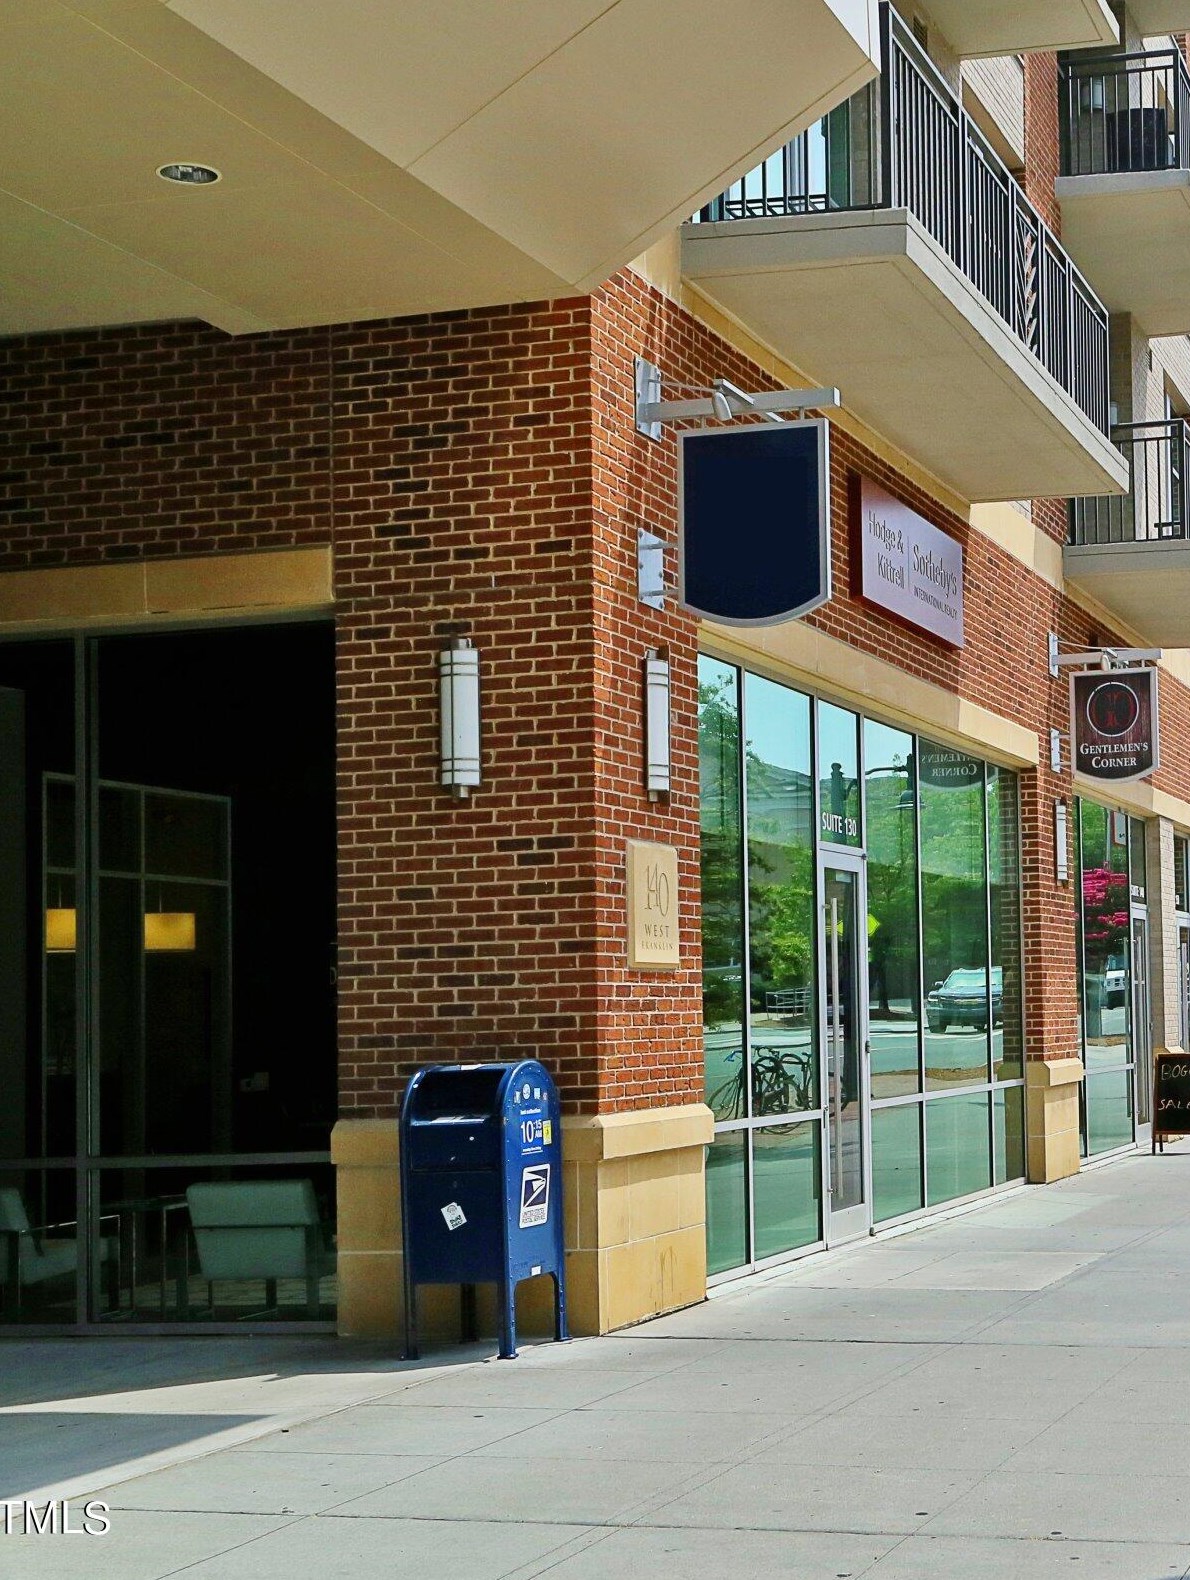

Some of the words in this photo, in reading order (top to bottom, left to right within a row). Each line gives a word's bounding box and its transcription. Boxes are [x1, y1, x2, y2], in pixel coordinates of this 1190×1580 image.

[868, 510, 895, 552] Hodge
[897, 529, 904, 554] &
[877, 552, 904, 589] Kittrell
[913, 544, 957, 598] Sotheby's
[913, 585, 944, 612] INTERNATIONAL
[1080, 742, 1148, 755] GENTLEMEN'S
[1091, 756, 1137, 768] CORNER
[822, 811, 843, 833] SUITE
[844, 817, 857, 837] 130
[644, 863, 669, 917] 140
[644, 923, 670, 938] WEST
[641, 941, 673, 951] FRANKLIN
